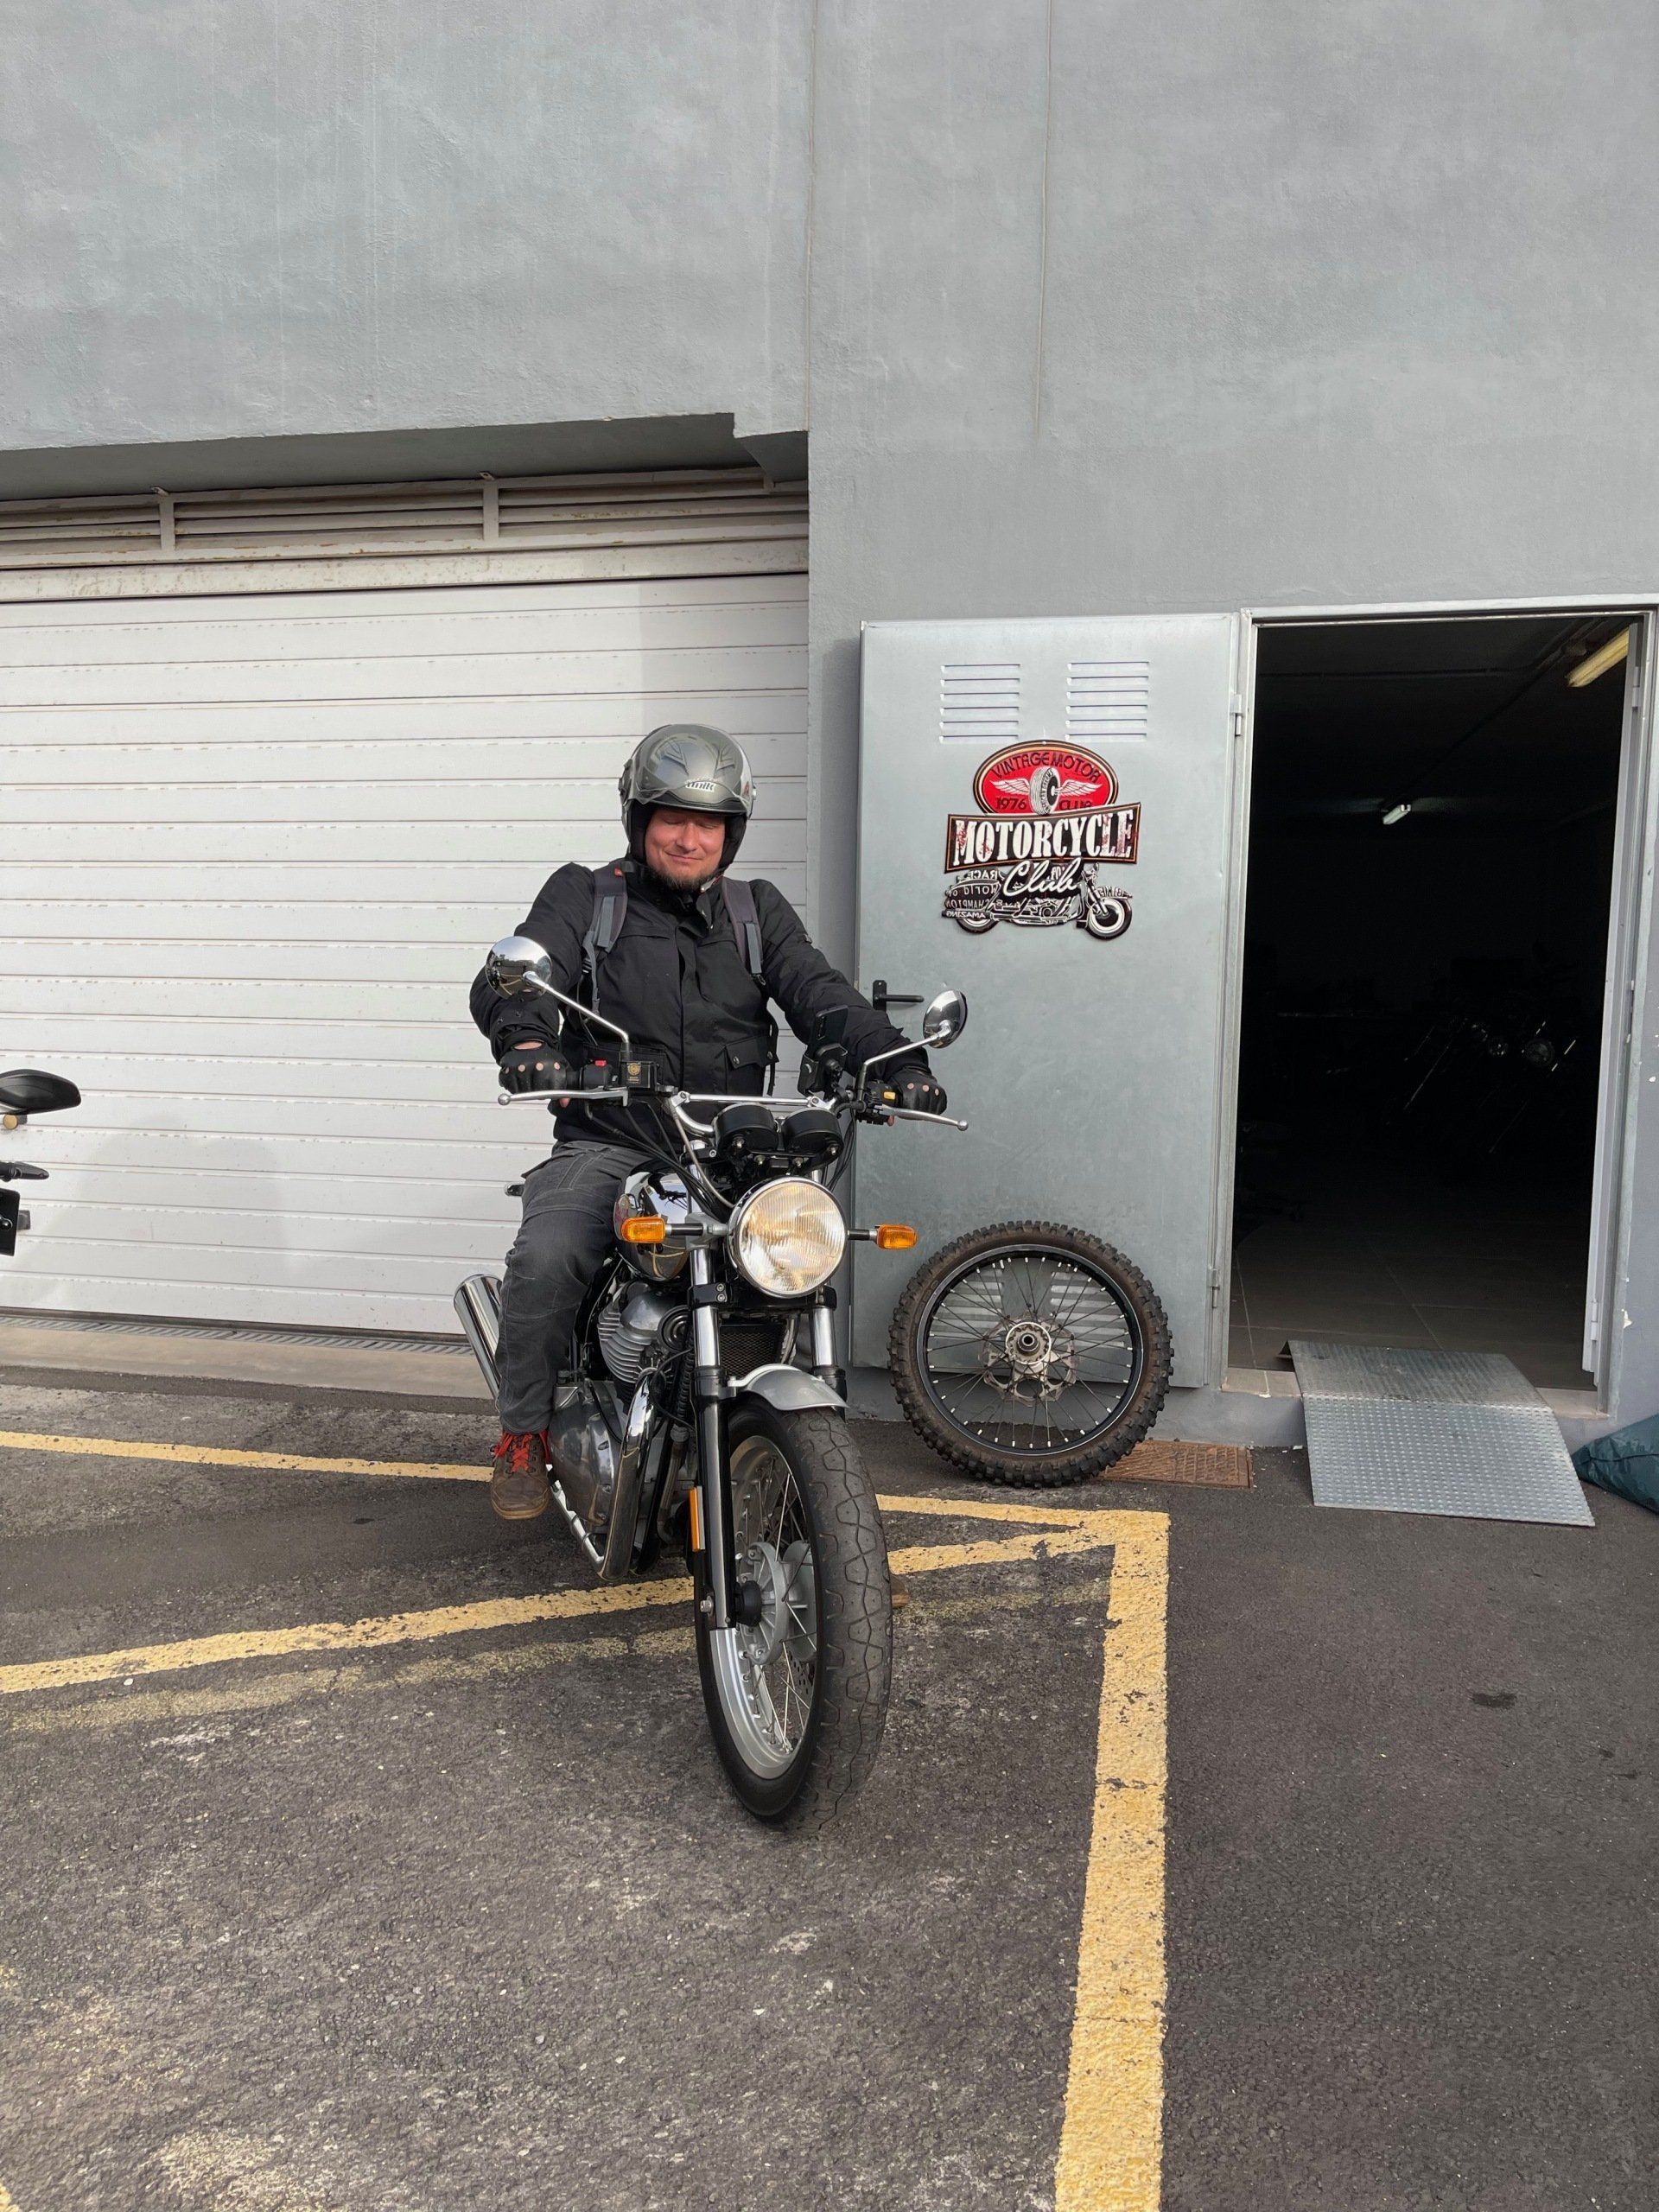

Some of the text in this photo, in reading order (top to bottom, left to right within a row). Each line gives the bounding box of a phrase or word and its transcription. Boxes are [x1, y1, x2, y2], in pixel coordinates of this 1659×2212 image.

[990, 752, 1102, 782] VINTAGE MOTOR
[995, 797, 1027, 810] 1976
[953, 809, 1134, 866] MOTORCYCLE
[1003, 857, 1082, 896] Club
